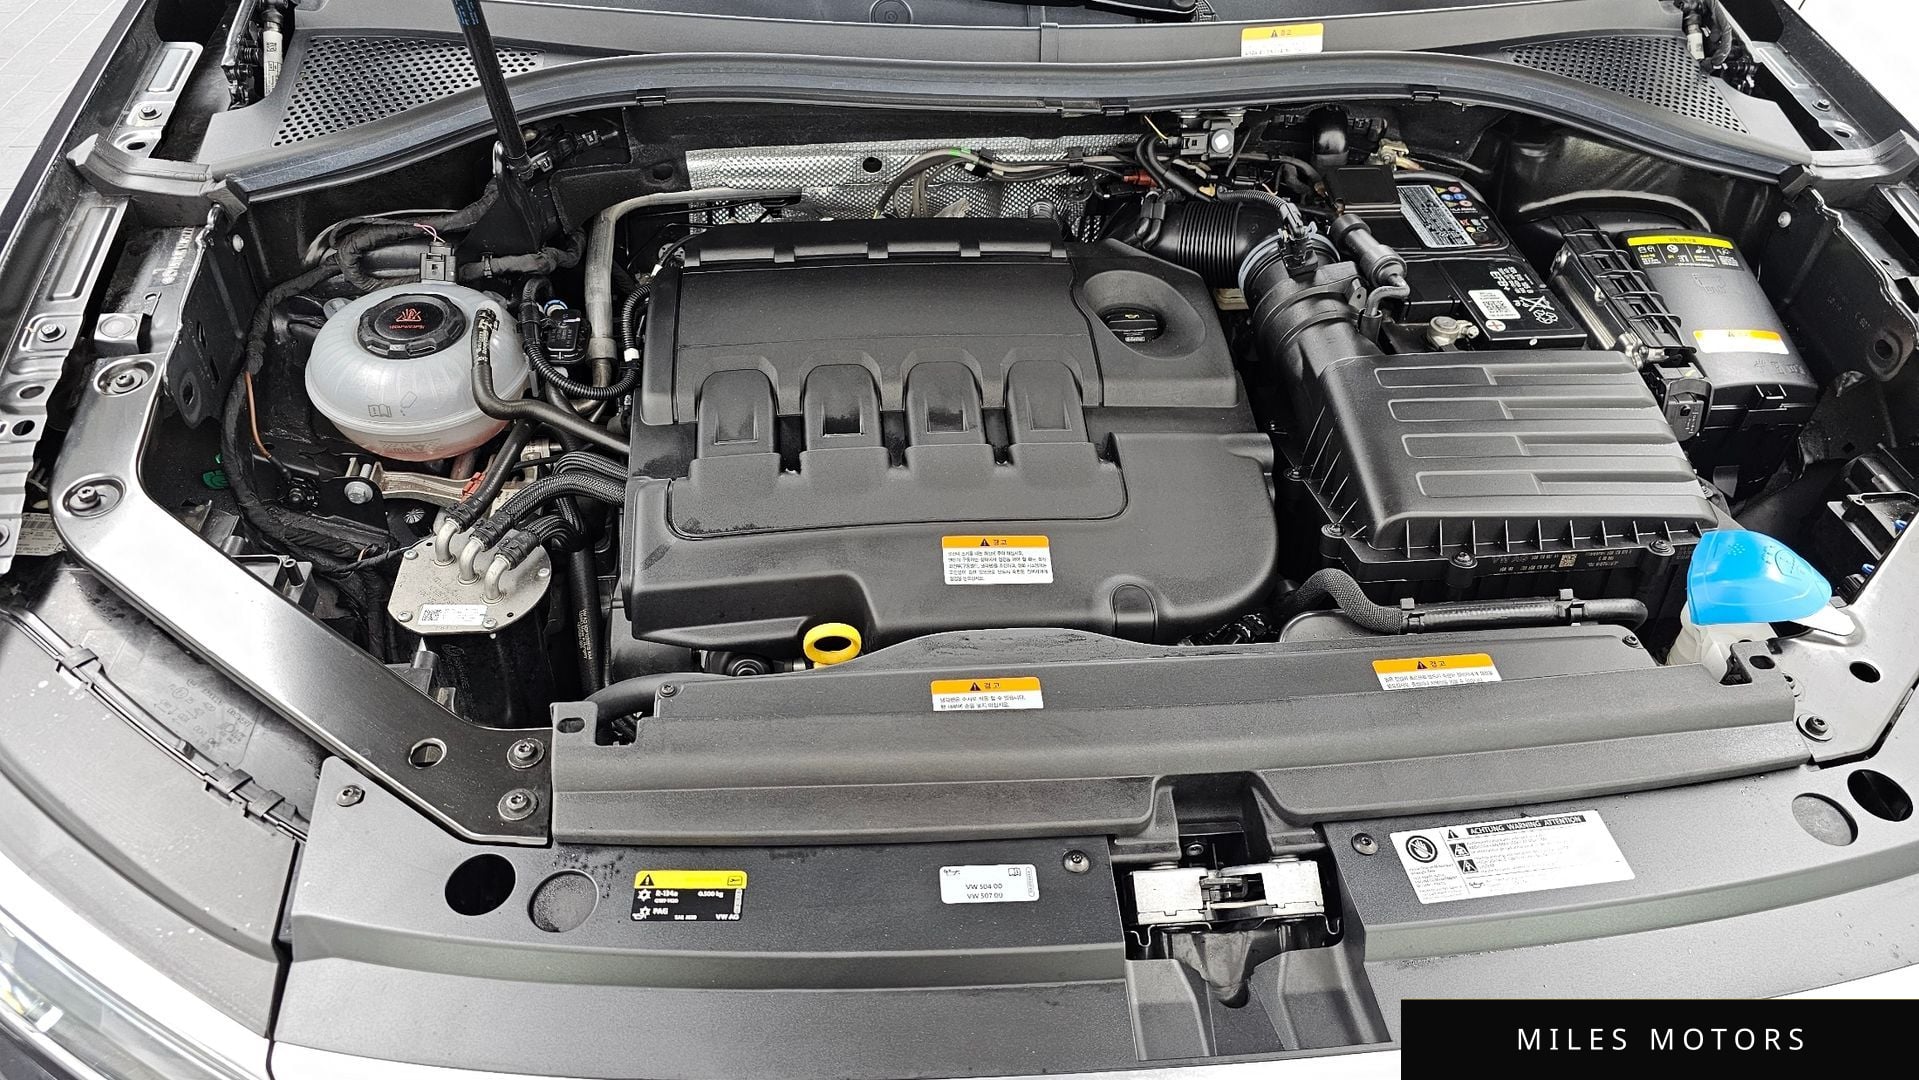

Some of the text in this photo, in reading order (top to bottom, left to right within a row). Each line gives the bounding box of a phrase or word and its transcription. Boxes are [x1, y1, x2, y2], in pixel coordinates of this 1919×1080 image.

[1470, 815, 1582, 835] ACHTUNG WARNING ATTENTION
